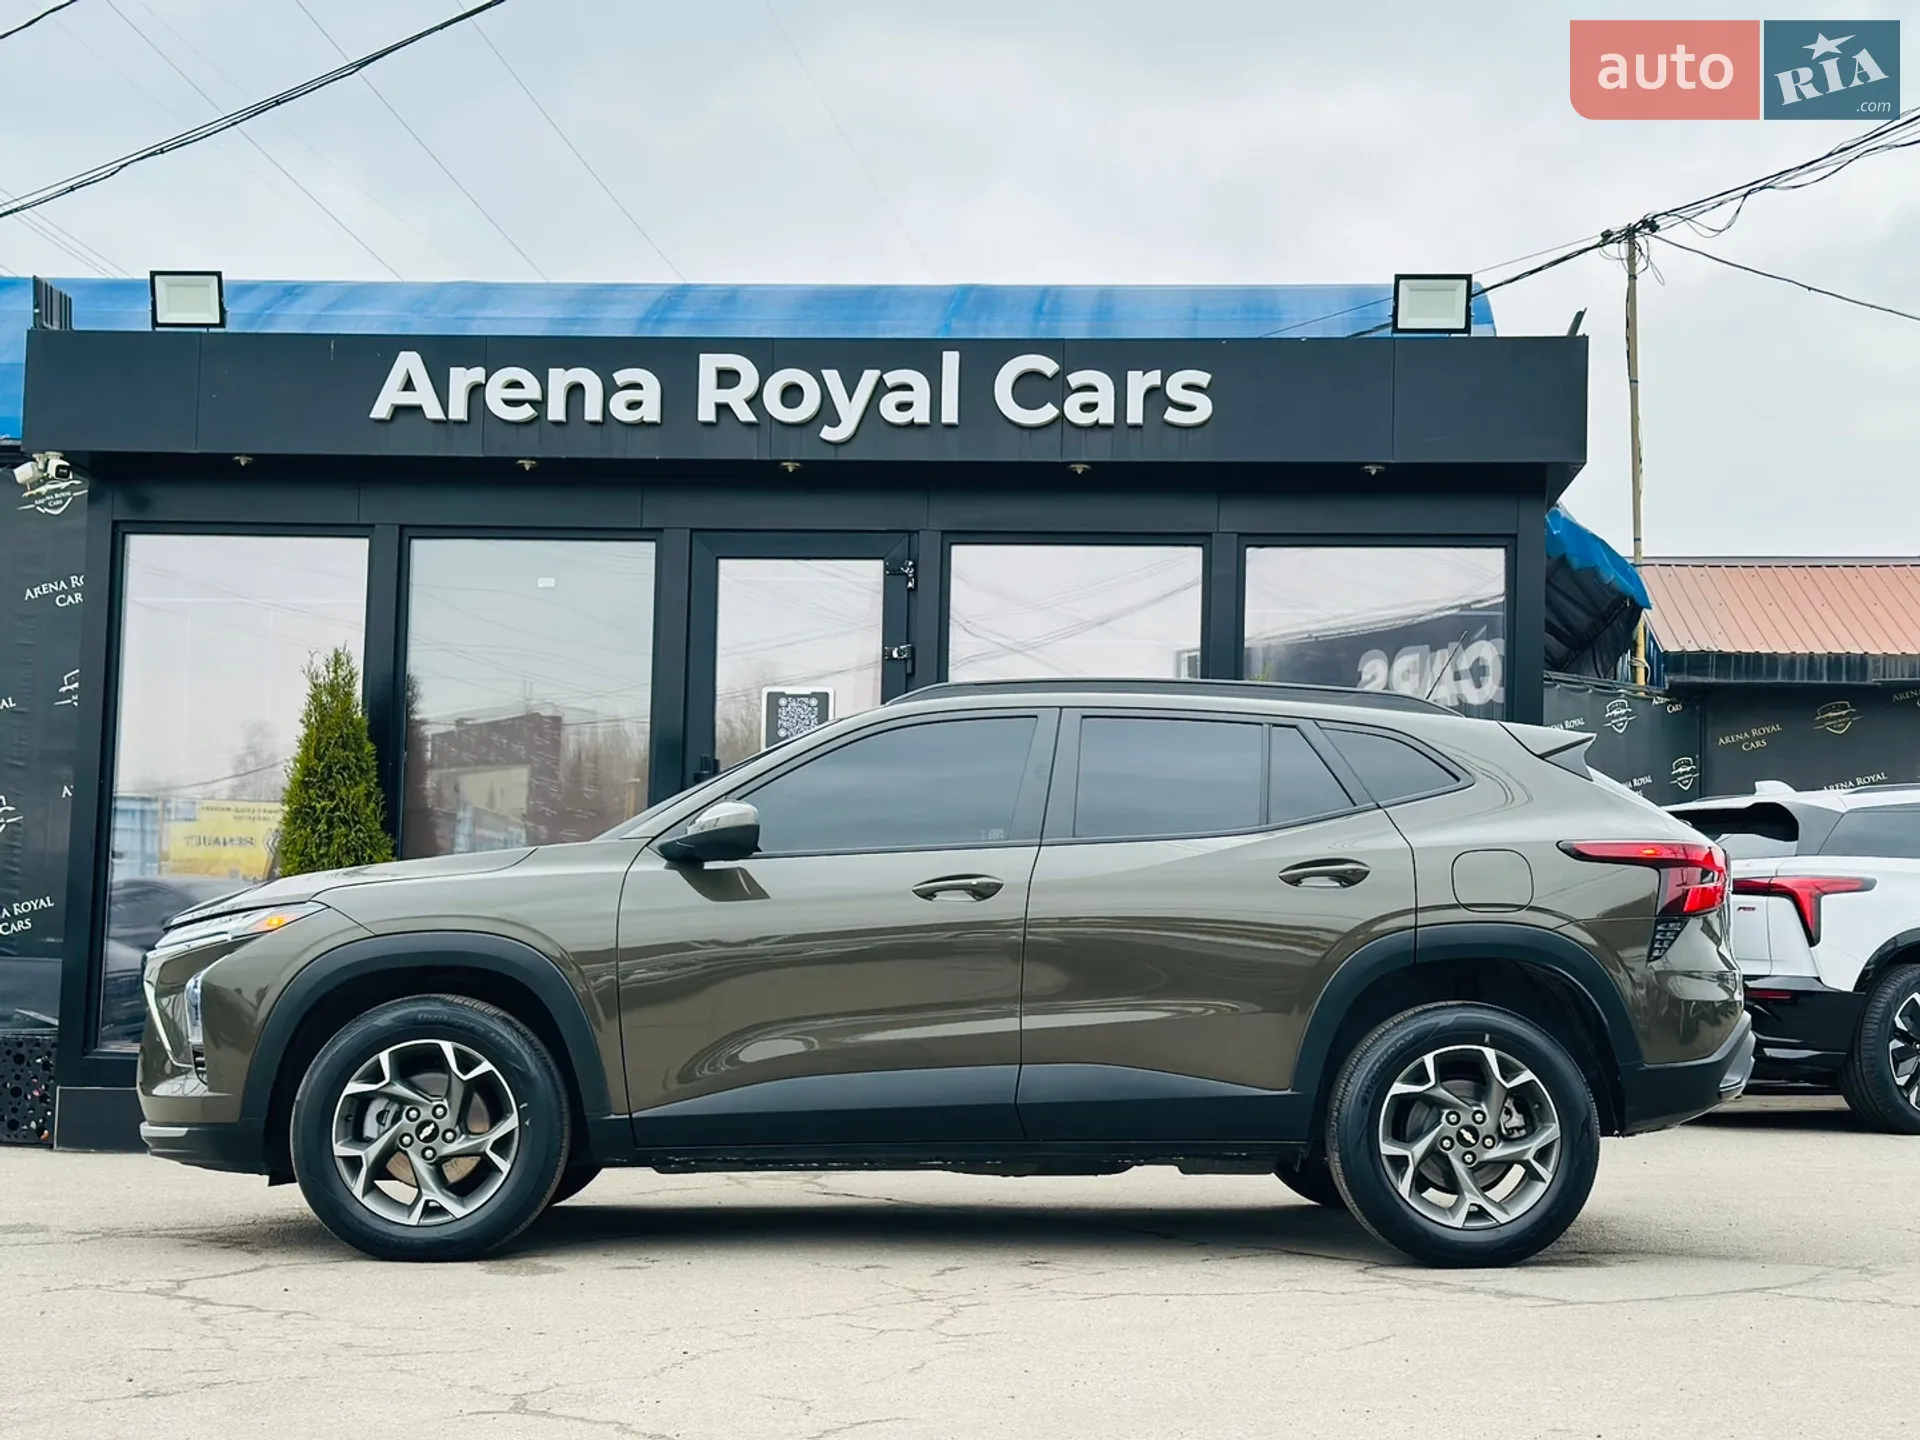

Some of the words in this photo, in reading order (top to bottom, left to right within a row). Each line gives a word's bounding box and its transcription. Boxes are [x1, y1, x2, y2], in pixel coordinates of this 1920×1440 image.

[370, 351, 660, 422] Arena
[698, 351, 959, 441] Royal
[995, 355, 1212, 424] Cars
[24, 580, 68, 601] ARENA
[1718, 732, 1750, 747] ARENA
[1751, 723, 1783, 739] ROYAL
[1741, 739, 1768, 752] CARS
[1855, 772, 1888, 786] ROYAL
[13, 896, 55, 916] ROYAL
[0, 918, 32, 935] CARS
